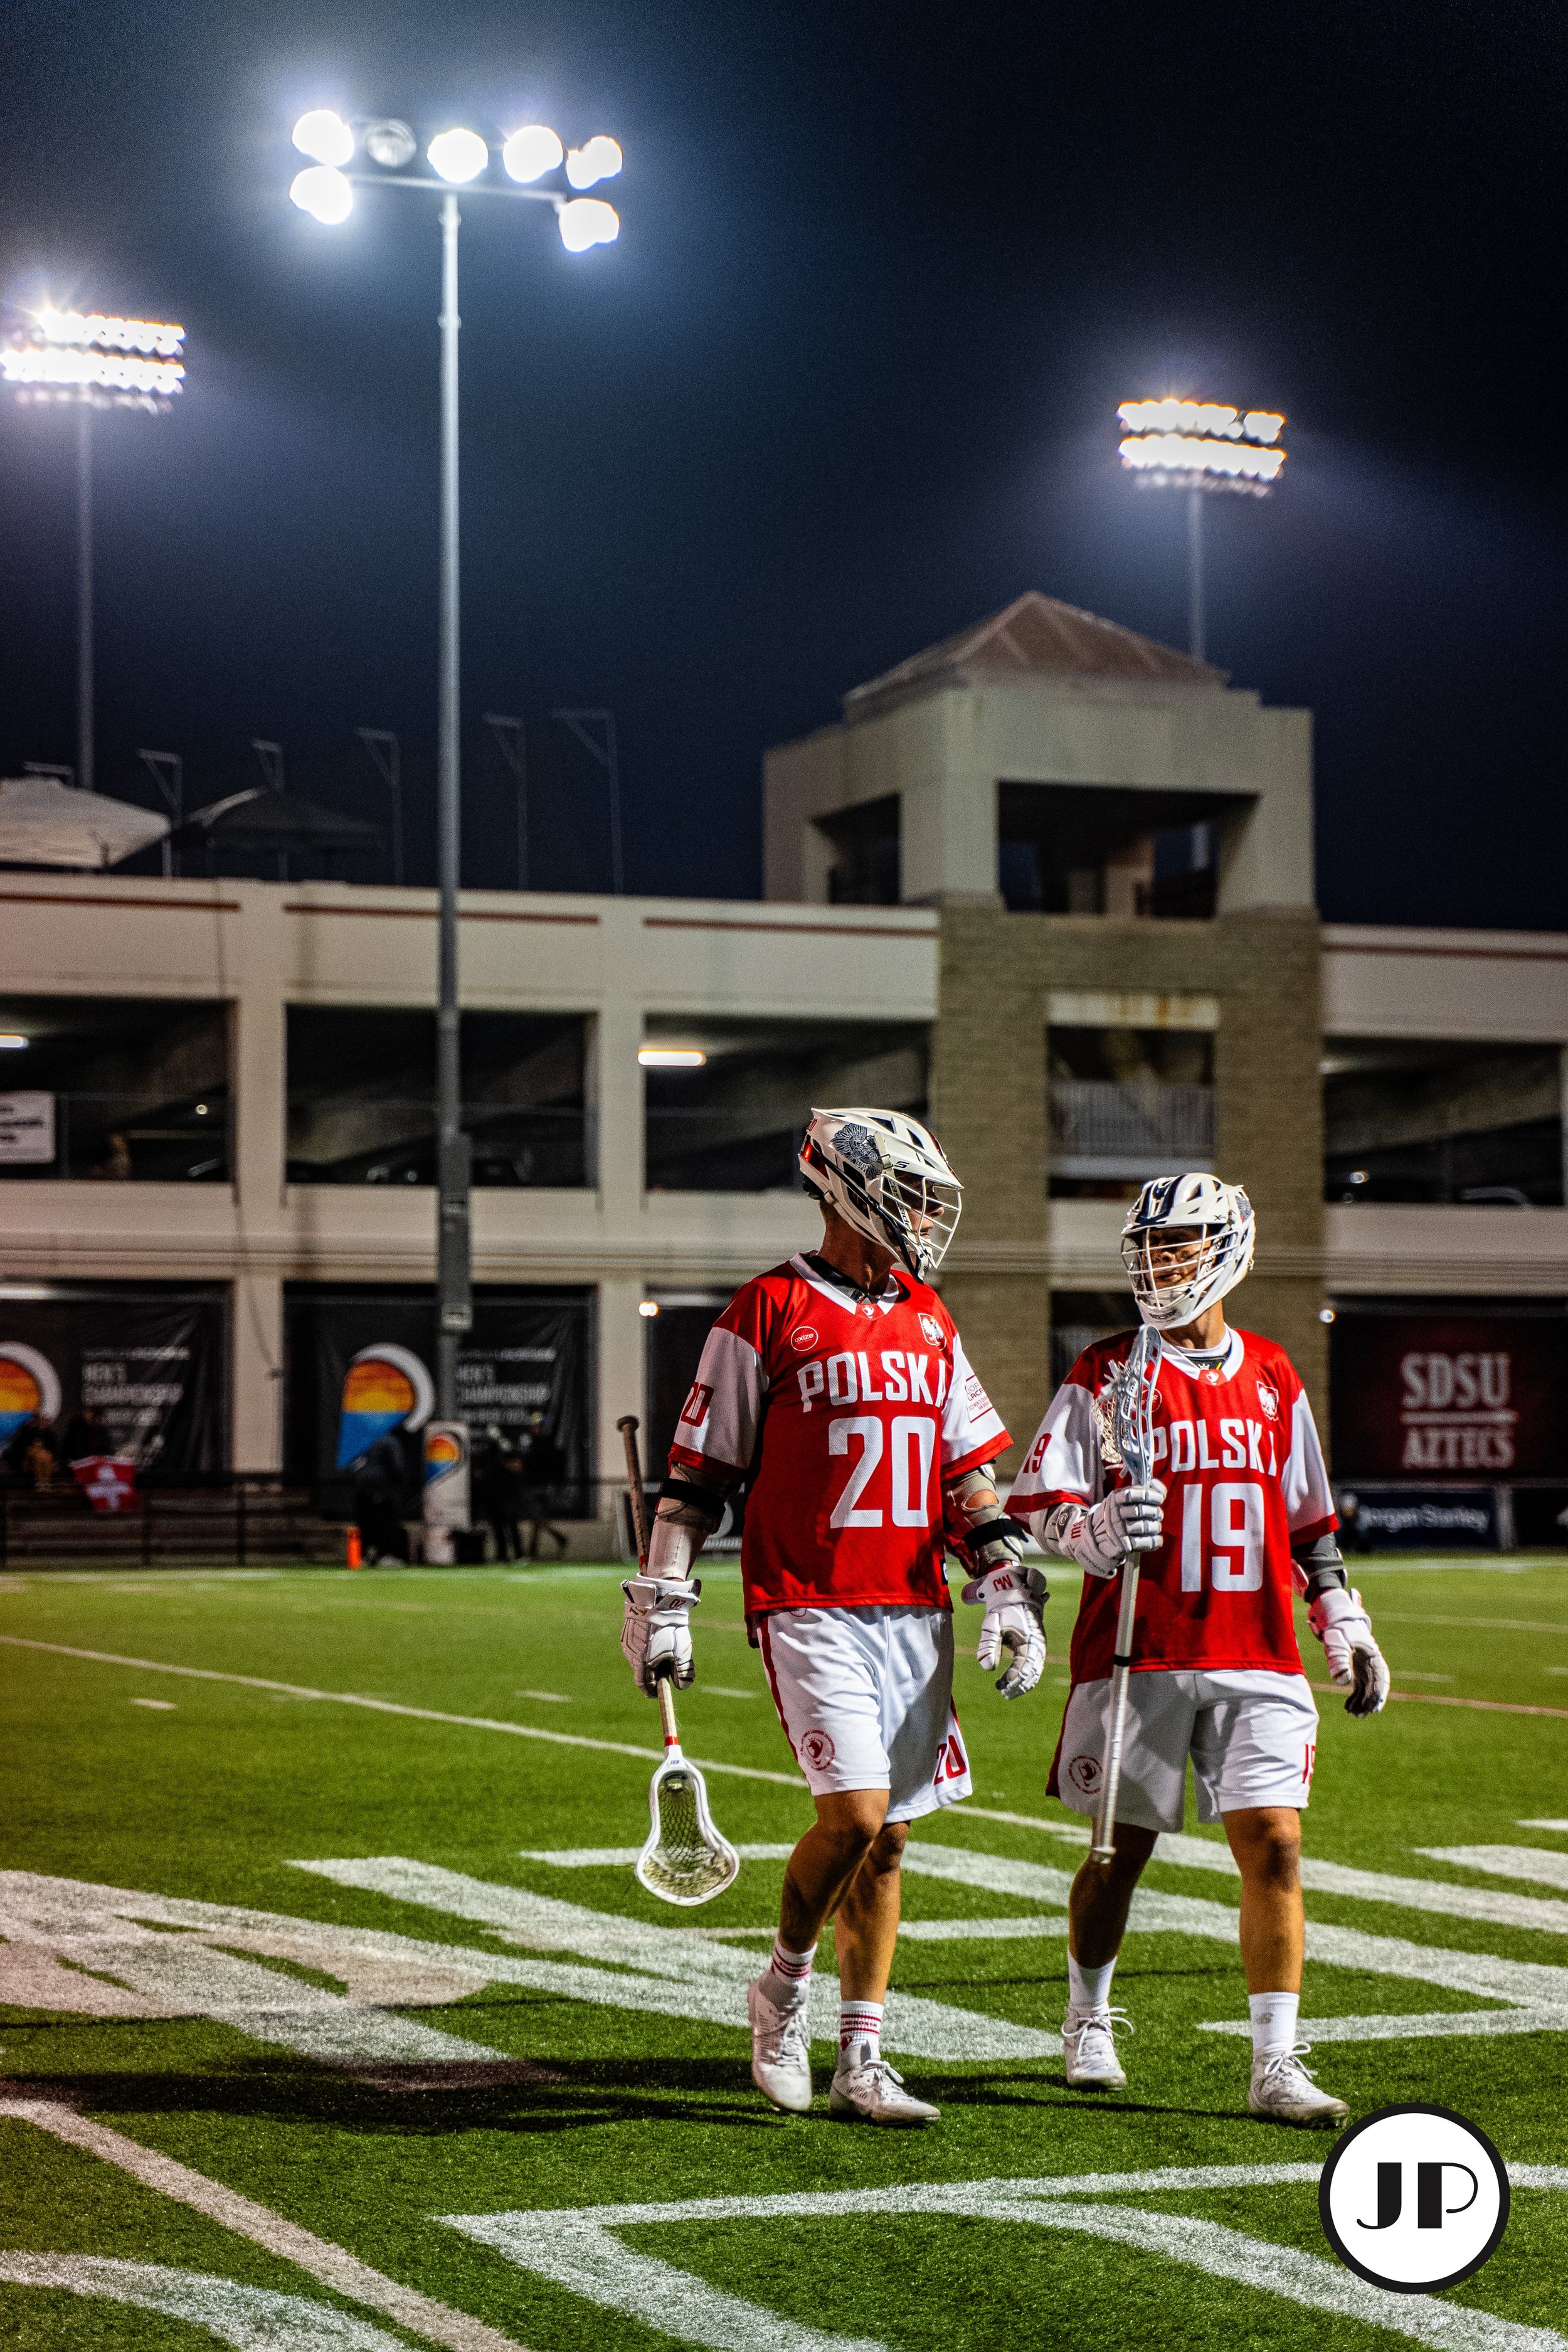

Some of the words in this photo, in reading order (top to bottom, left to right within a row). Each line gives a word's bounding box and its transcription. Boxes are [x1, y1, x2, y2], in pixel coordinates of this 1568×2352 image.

[680, 1381, 714, 1428] 20
[1401, 1352, 1512, 1409] SDSU
[829, 1416, 936, 1528] 20
[1023, 1433, 1052, 1474] 19
[1401, 1425, 1516, 1469] AZTECS
[1181, 1482, 1265, 1592] 19
[933, 1734, 968, 1786] 20
